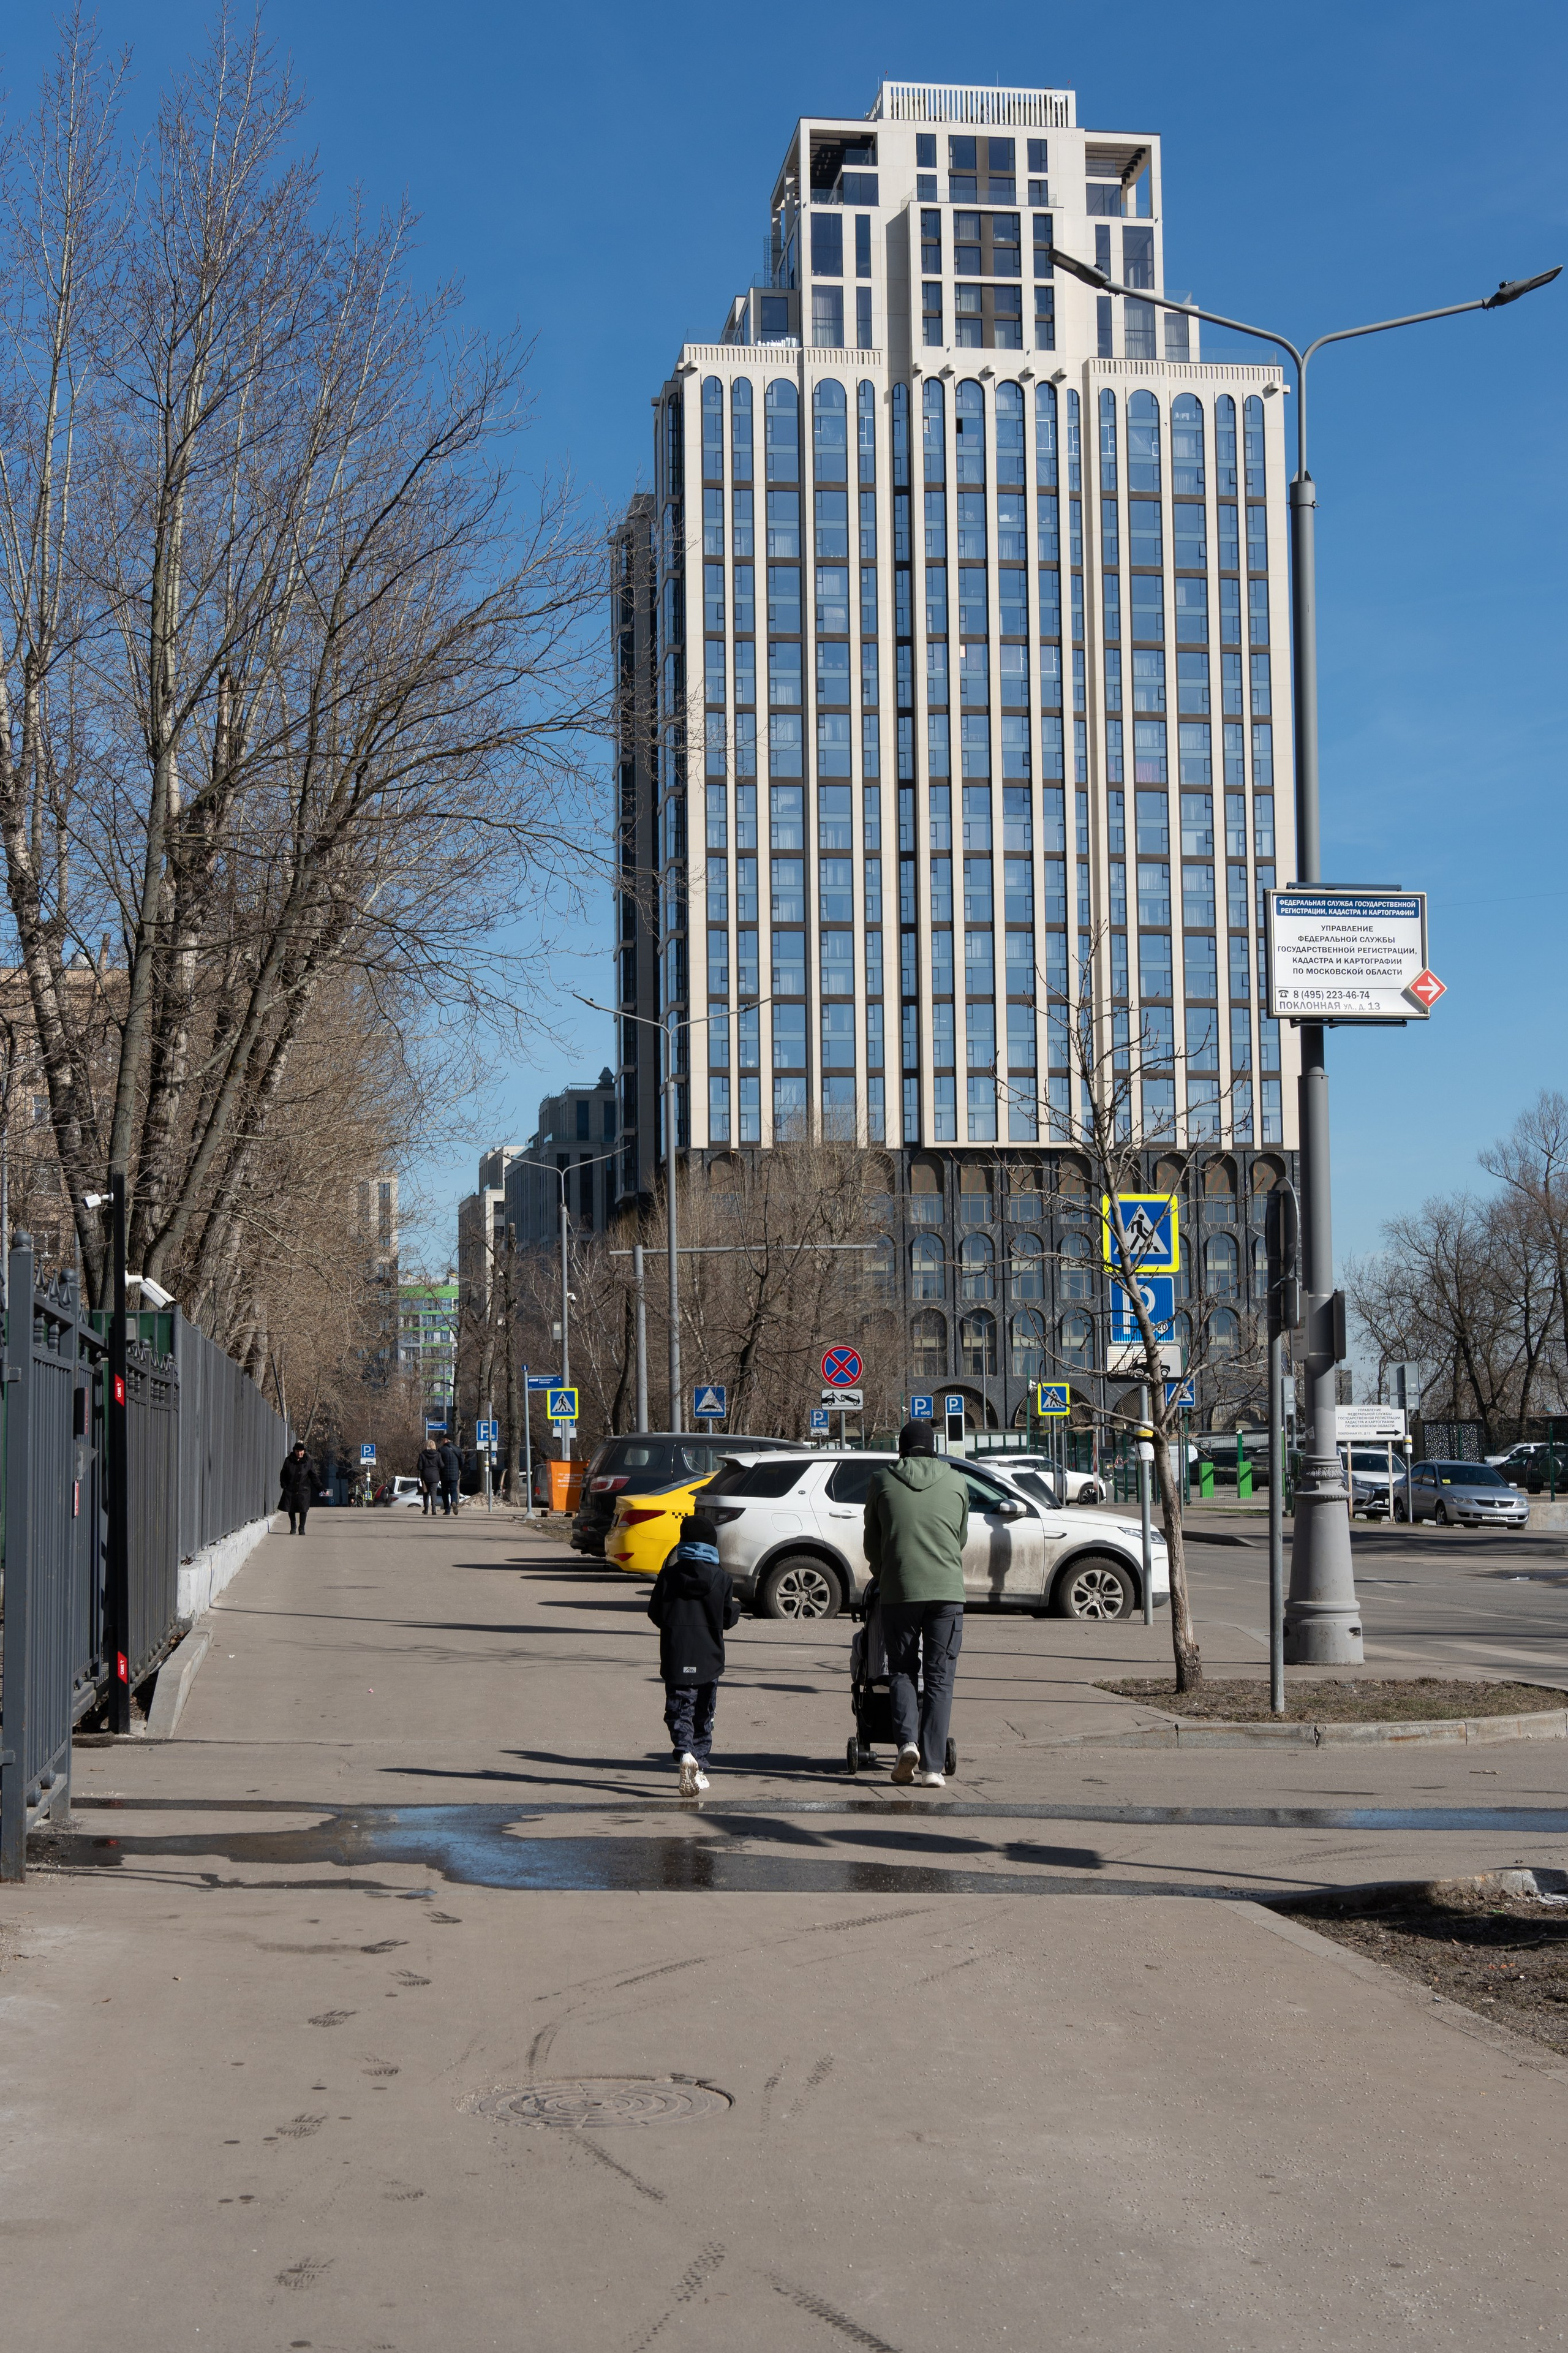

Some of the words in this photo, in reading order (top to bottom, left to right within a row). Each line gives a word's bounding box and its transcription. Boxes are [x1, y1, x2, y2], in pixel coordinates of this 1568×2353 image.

[1293, 990, 1298, 999] 8
[1301, 990, 1324, 1000] (495)
[1326, 991, 1370, 999] 223-46-74
[1280, 1001, 1341, 1010] ПОКЛОННАЯ
